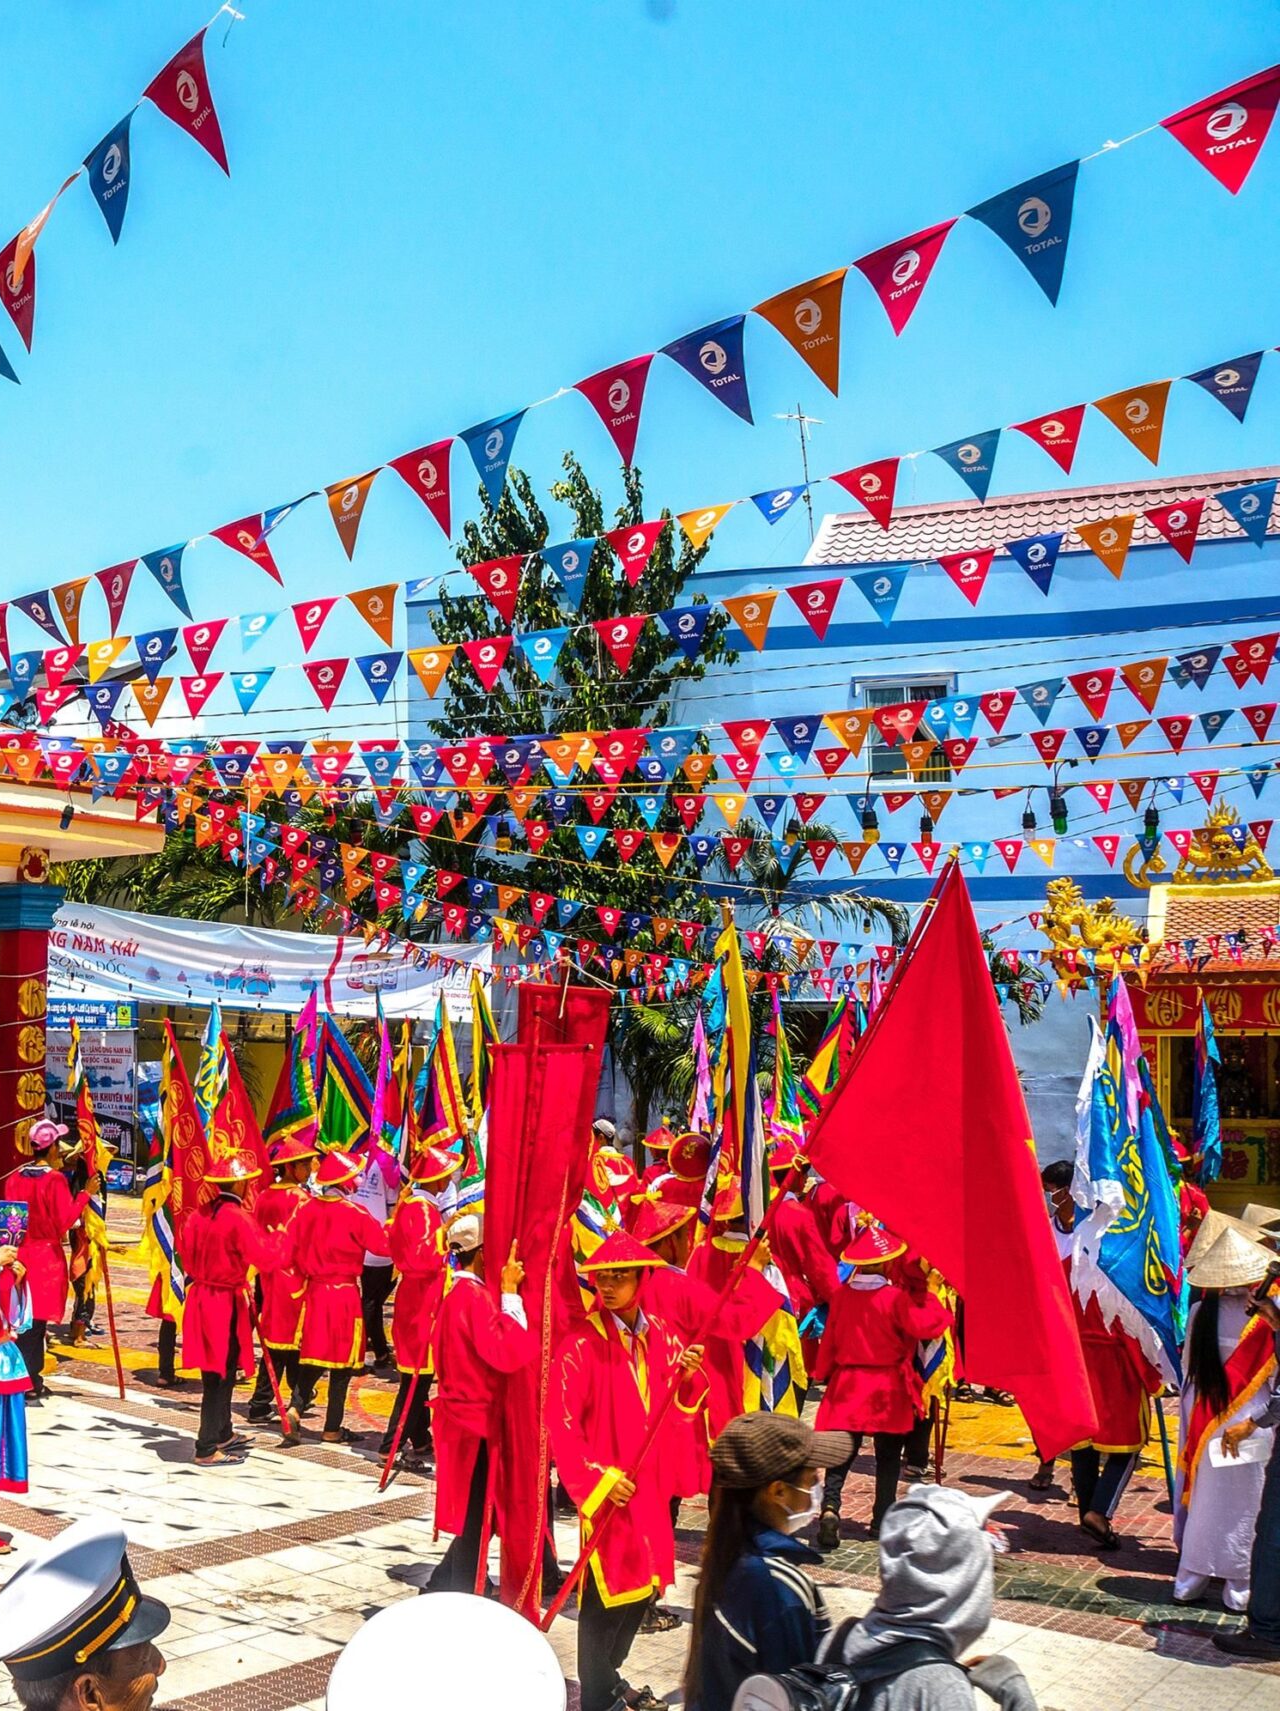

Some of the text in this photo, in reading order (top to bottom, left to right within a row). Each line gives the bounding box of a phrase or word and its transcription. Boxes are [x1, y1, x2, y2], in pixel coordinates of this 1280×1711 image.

[1205, 134, 1256, 156] TOTAL
[1024, 235, 1062, 256] TOTAL
[888, 278, 922, 300] TOTAL
[801, 334, 834, 351] TOTAL
[710, 372, 741, 388] TOTAL
[610, 410, 636, 428] TOTAL
[1128, 422, 1157, 435] TOTAL
[72, 934, 106, 954] NAM
[110, 938, 140, 958] HẢI
